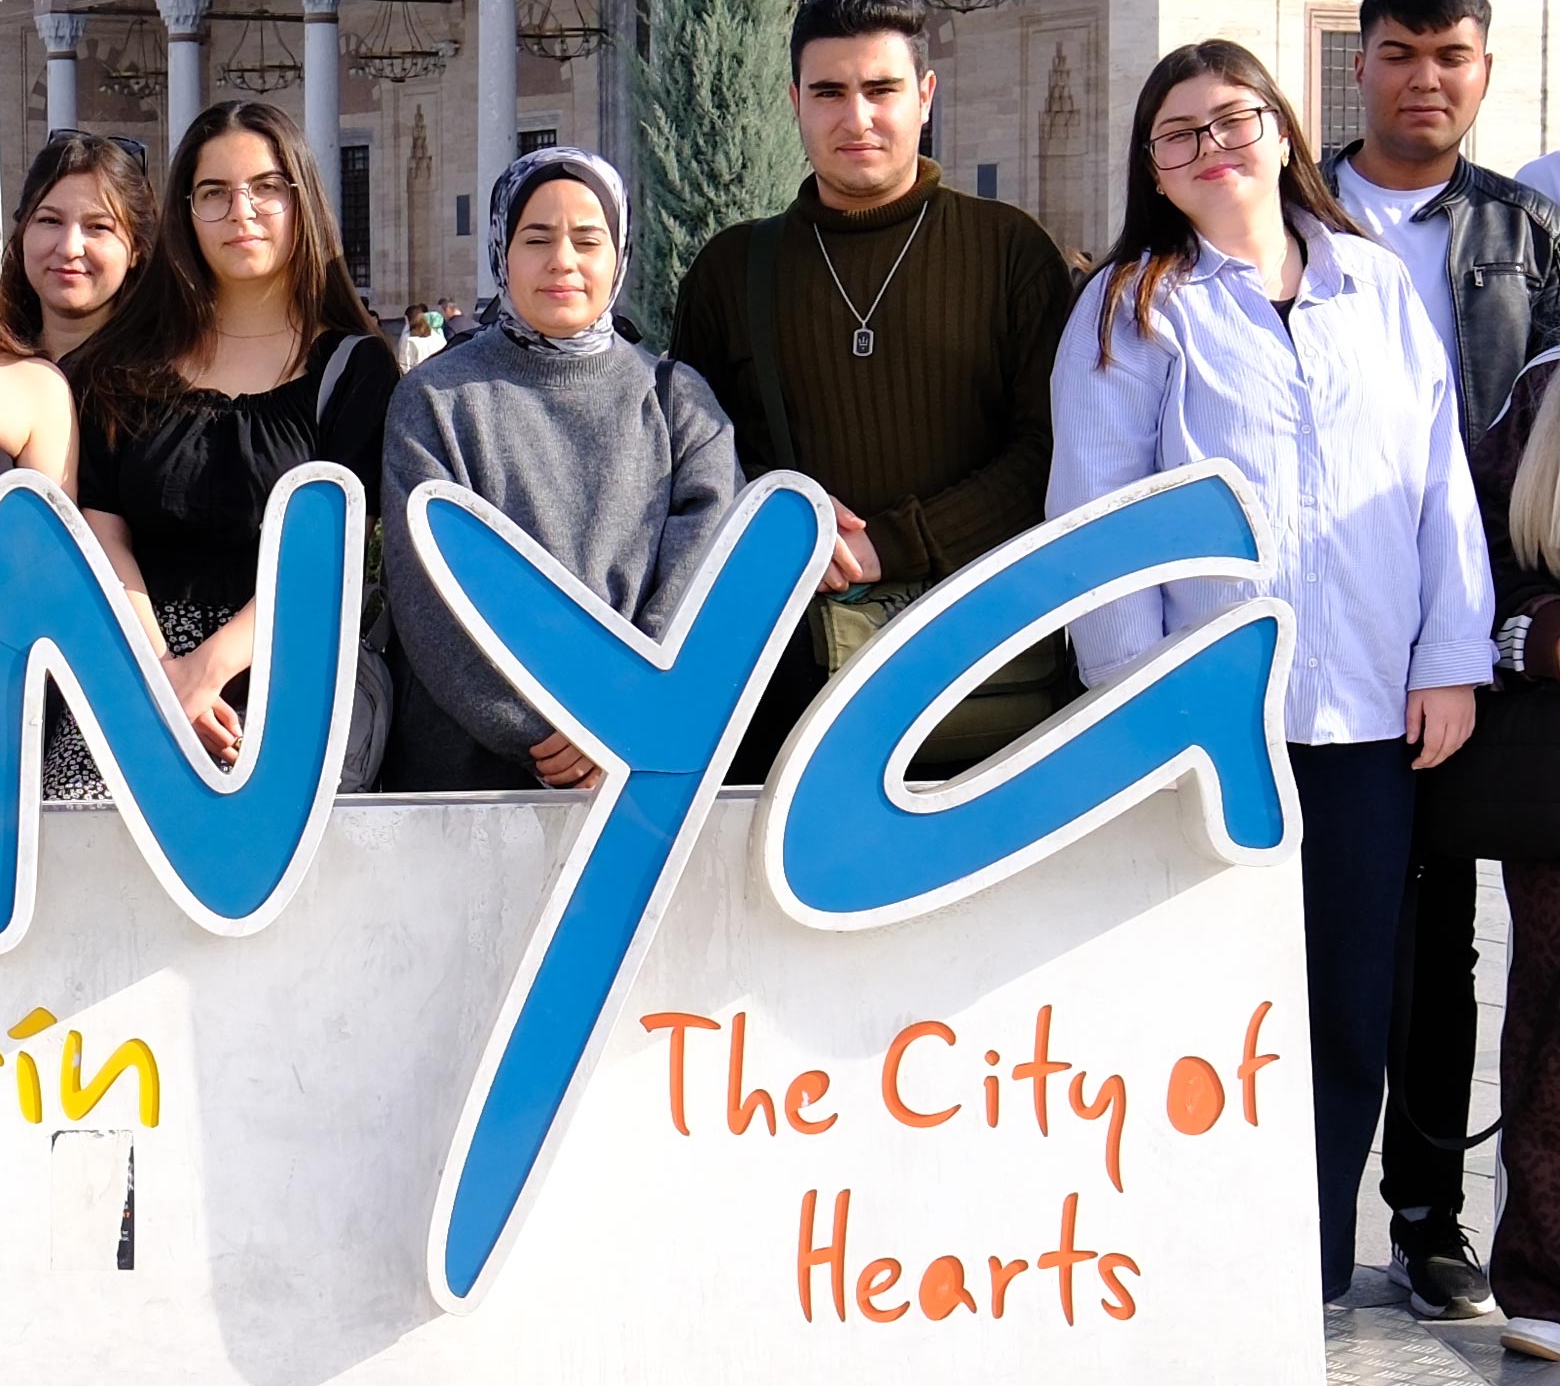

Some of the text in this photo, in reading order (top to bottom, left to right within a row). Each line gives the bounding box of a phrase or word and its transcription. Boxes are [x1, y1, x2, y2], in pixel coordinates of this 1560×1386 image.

[641, 1001, 1280, 1192] The City of
[798, 1189, 1140, 1325] Hearts
